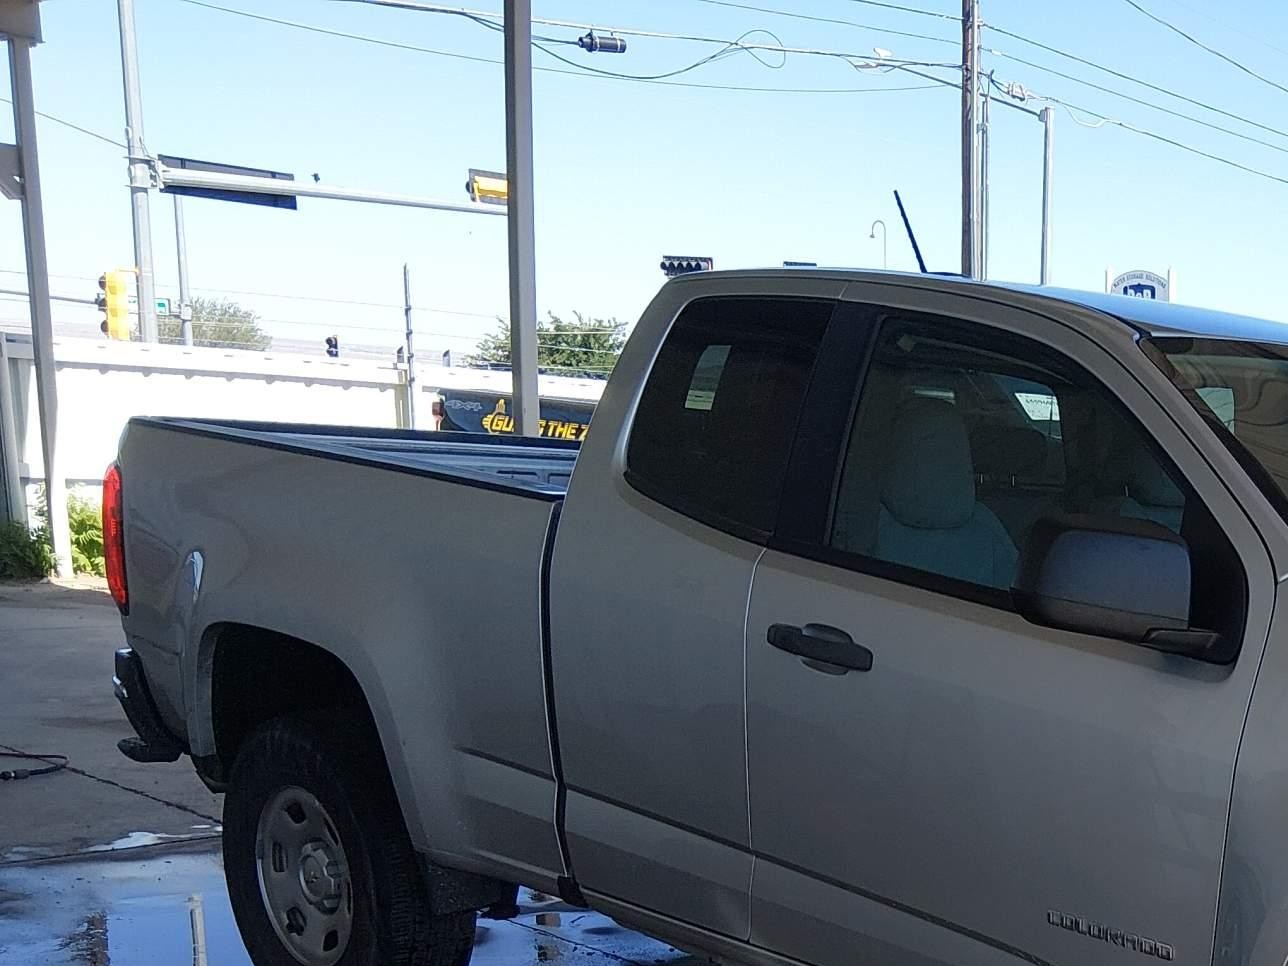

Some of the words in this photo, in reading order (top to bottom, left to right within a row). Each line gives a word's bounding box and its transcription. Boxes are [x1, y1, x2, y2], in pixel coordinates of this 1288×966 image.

[1145, 274, 1167, 289] SOLUTIONS
[548, 420, 579, 440] THE
[1047, 909, 1175, 961] COLORADO
